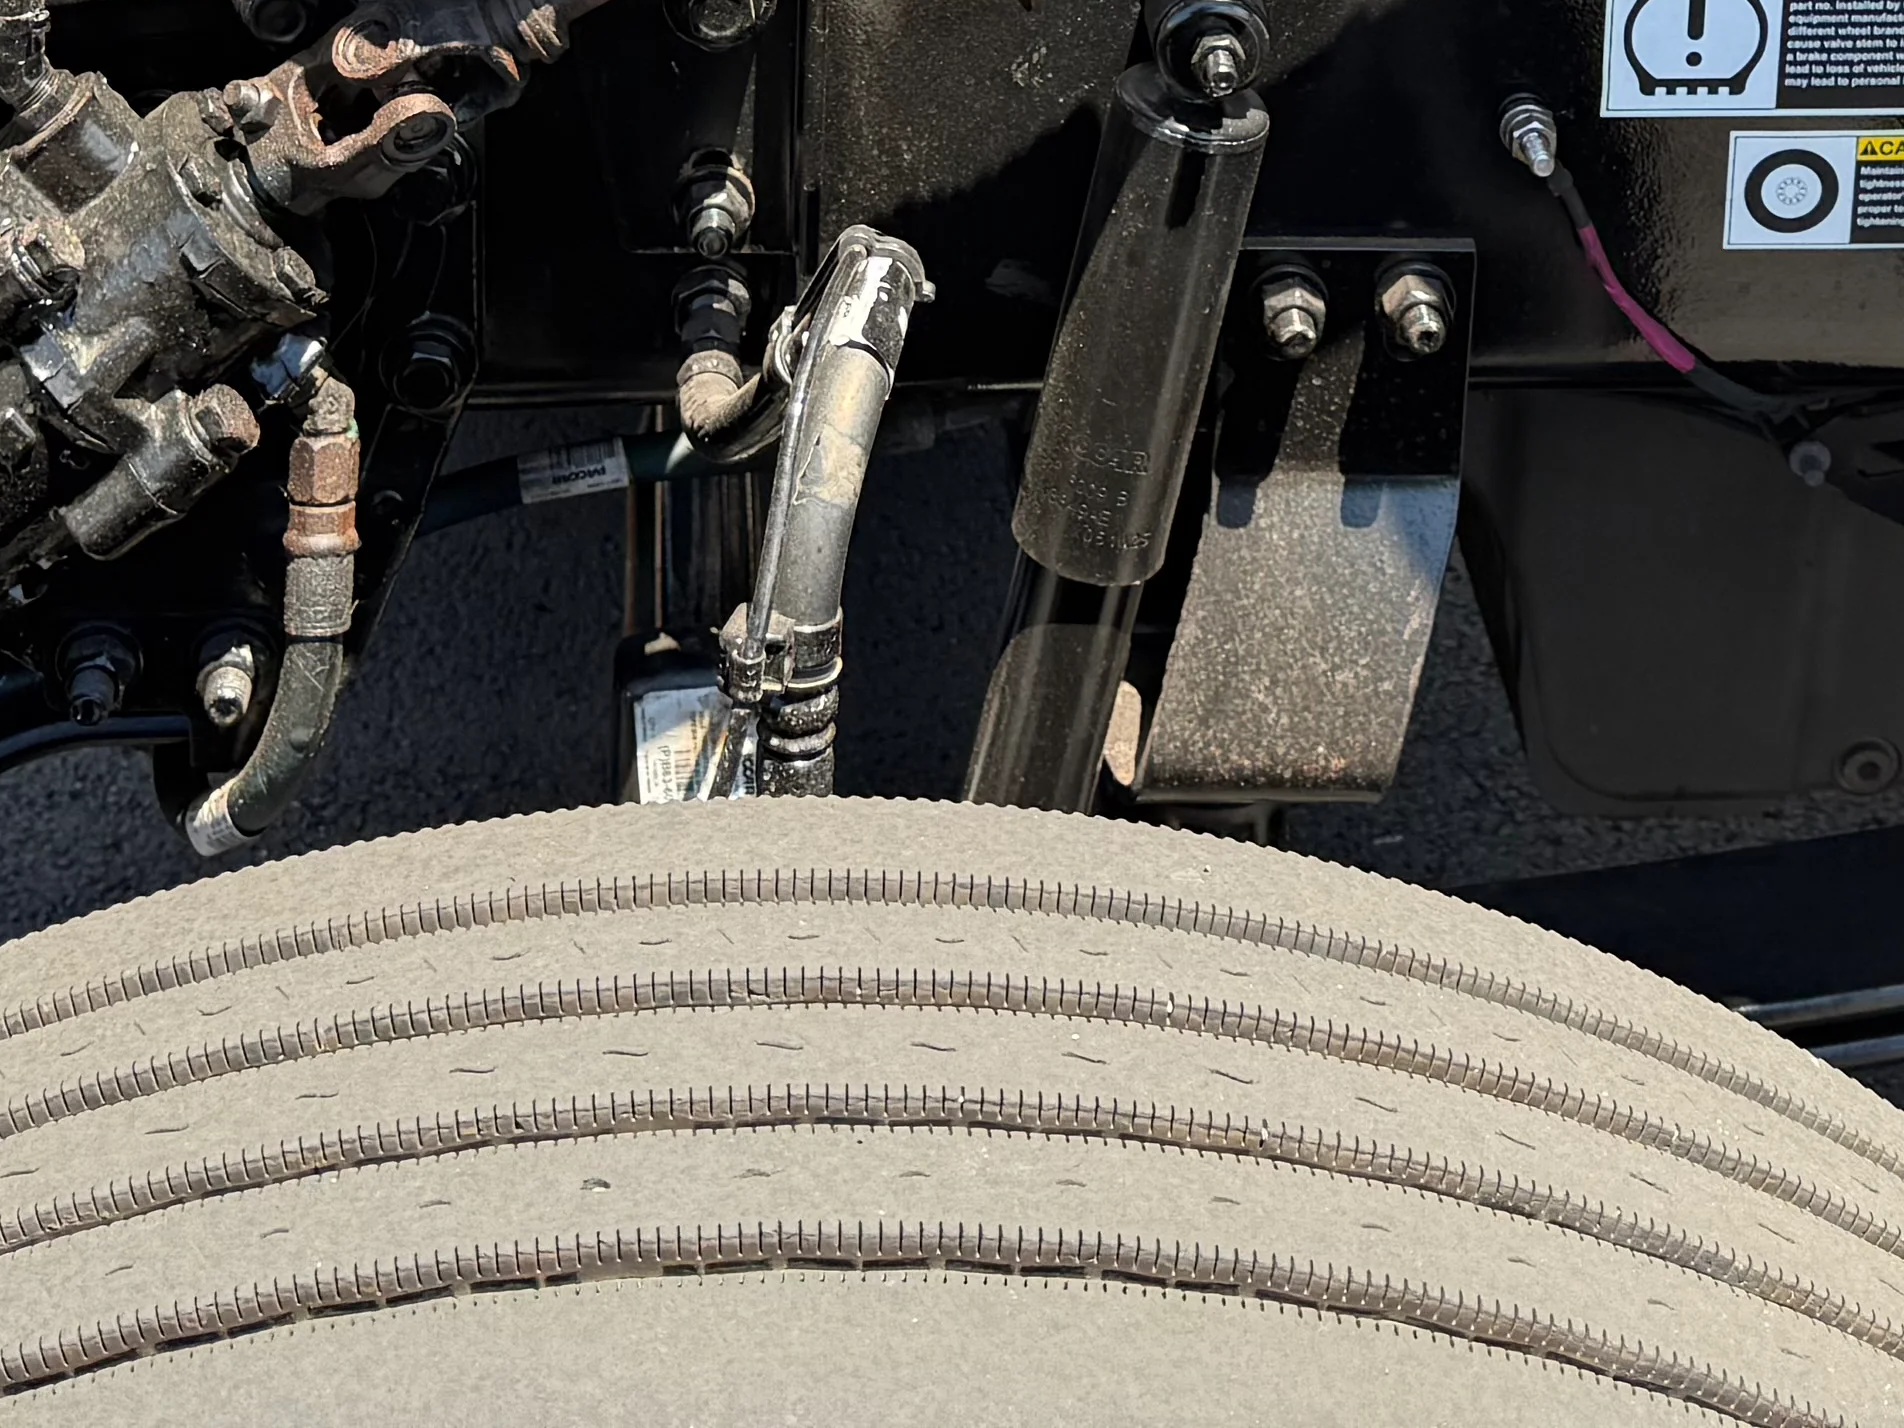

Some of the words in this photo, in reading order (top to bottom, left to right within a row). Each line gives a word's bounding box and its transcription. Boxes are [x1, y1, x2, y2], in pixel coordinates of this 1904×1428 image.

[1789, 2, 1812, 11] part
[1835, 0, 1883, 9] installed
[1886, 0, 1900, 11] by
[1788, 14, 1848, 23] equipment
[1788, 26, 1835, 35] different
[1838, 26, 1870, 35] wheel
[1787, 40, 1820, 48] cause
[1856, 39, 1883, 47] stem
[1886, 39, 1897, 47] to
[1796, 52, 1827, 60] brake
[1830, 52, 1893, 61] component
[1785, 64, 1809, 73] lead
[1811, 64, 1823, 73] to
[1826, 65, 1849, 73] loss
[1852, 64, 1864, 72] of
[1784, 78, 1808, 88] may
[1810, 77, 1834, 86] lead
[1837, 77, 1849, 85] to
[1851, 77, 1900, 86] personal
